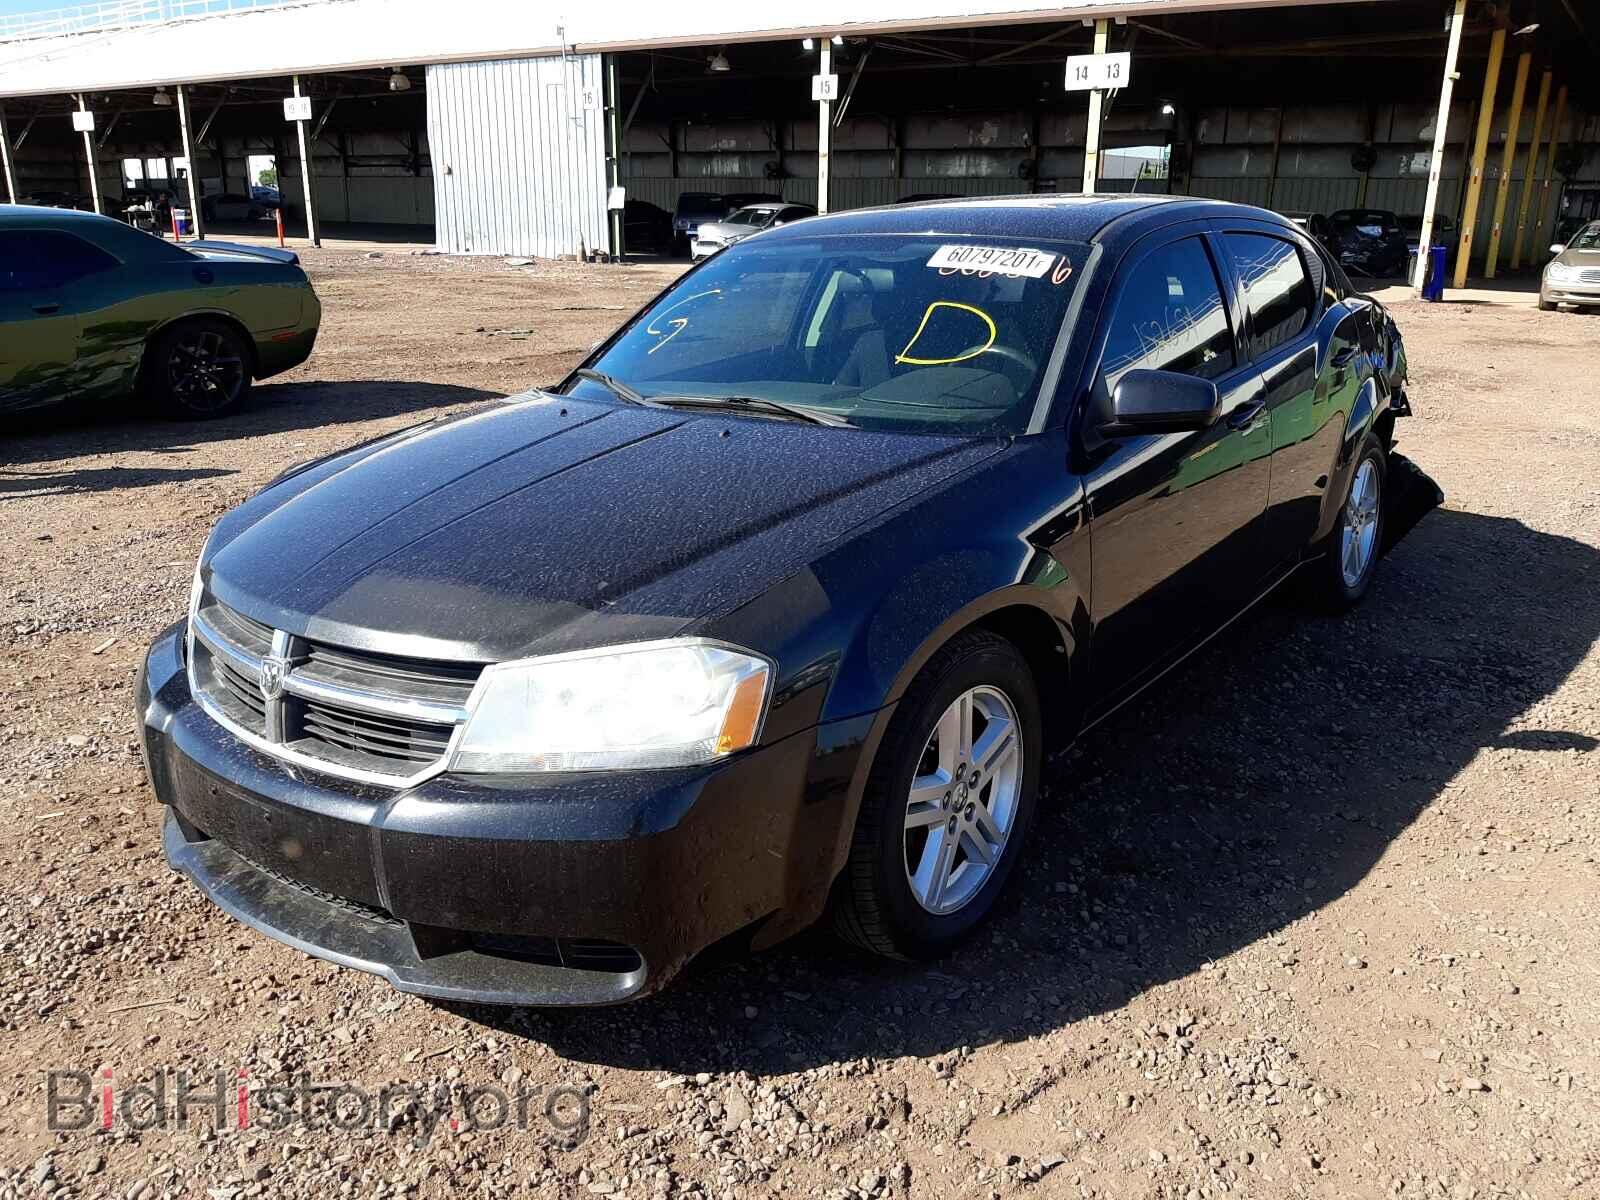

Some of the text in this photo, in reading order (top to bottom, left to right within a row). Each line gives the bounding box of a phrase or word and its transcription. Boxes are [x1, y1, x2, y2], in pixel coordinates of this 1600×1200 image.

[1075, 62, 1120, 81] 14 13
[820, 80, 830, 94] 15
[583, 91, 593, 105] 16
[894, 301, 997, 366] D
